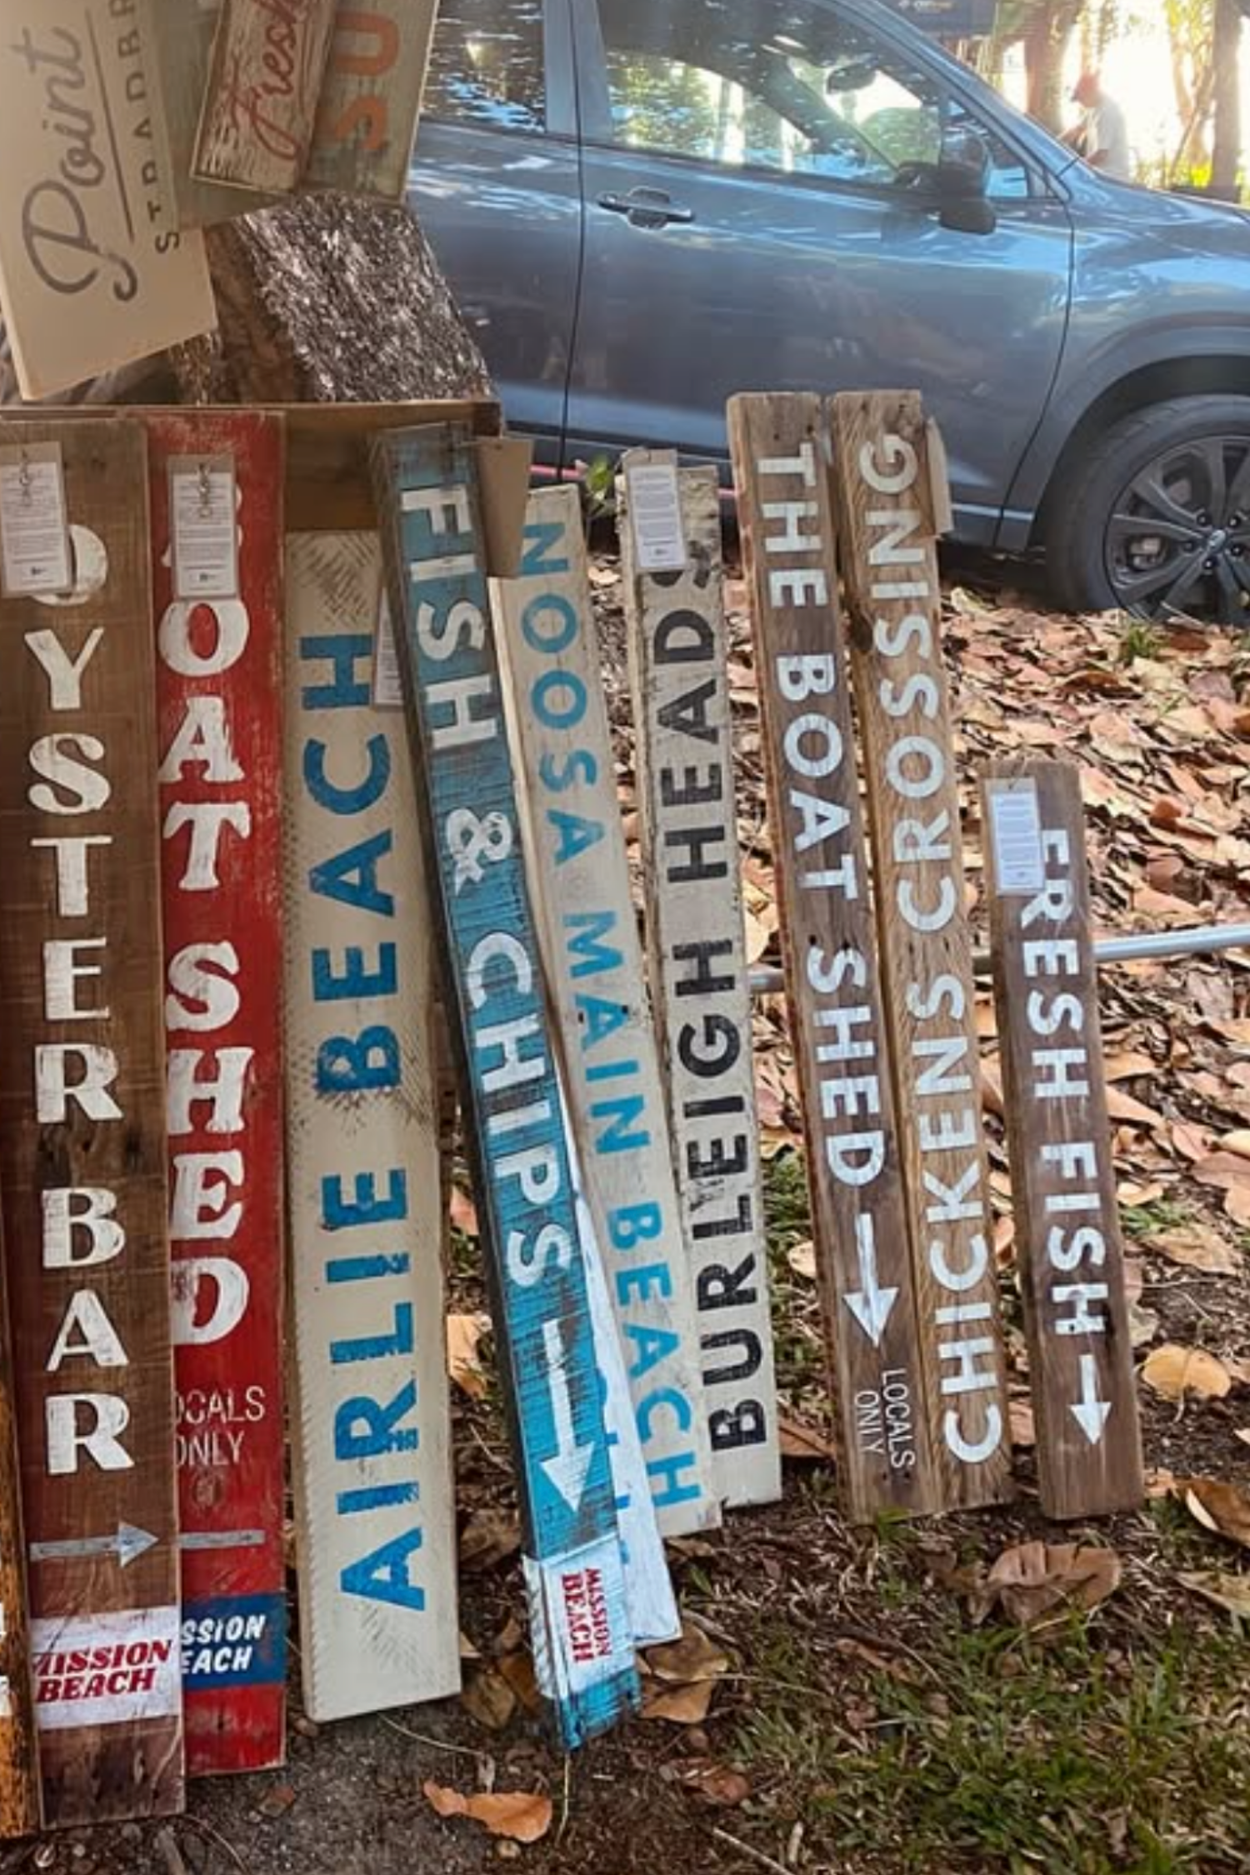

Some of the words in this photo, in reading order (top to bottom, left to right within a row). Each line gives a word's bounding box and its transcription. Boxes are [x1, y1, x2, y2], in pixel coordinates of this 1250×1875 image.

[8, 27, 138, 302] Point
[401, 487, 500, 751] FISH
[756, 443, 827, 608] THE
[158, 484, 251, 891] OAT
[777, 653, 857, 899] BOAT
[858, 433, 957, 932] CROSSING
[299, 634, 402, 1095] BEACH
[448, 806, 514, 892] &
[1021, 829, 1091, 1099] FRESH
[465, 930, 572, 1290] CHIPS
[519, 521, 600, 866] NOOSA
[561, 906, 650, 1157] MAIN
[607, 1203, 702, 1510] BEACH
[806, 944, 885, 1186] SHED
[165, 941, 254, 1347] SHED
[671, 936, 767, 1453] BURLEIGH
[907, 973, 1003, 1463] CHICKENS
[1041, 1140, 1110, 1337] FISH
[41, 1186, 136, 1476] BAR
[174, 1384, 267, 1425] CALS
[320, 1168, 427, 1611] AIRLIE
[853, 1388, 886, 1456] ONLY
[879, 1368, 917, 1470] LOCALS
[31, 1638, 172, 1678] MISSION
[36, 1668, 157, 1705] BEACH
[181, 1615, 268, 1644] SSION
[181, 1646, 253, 1675] EACH
[560, 1572, 595, 1664] BEACH
[584, 1564, 612, 1659] MISSION
